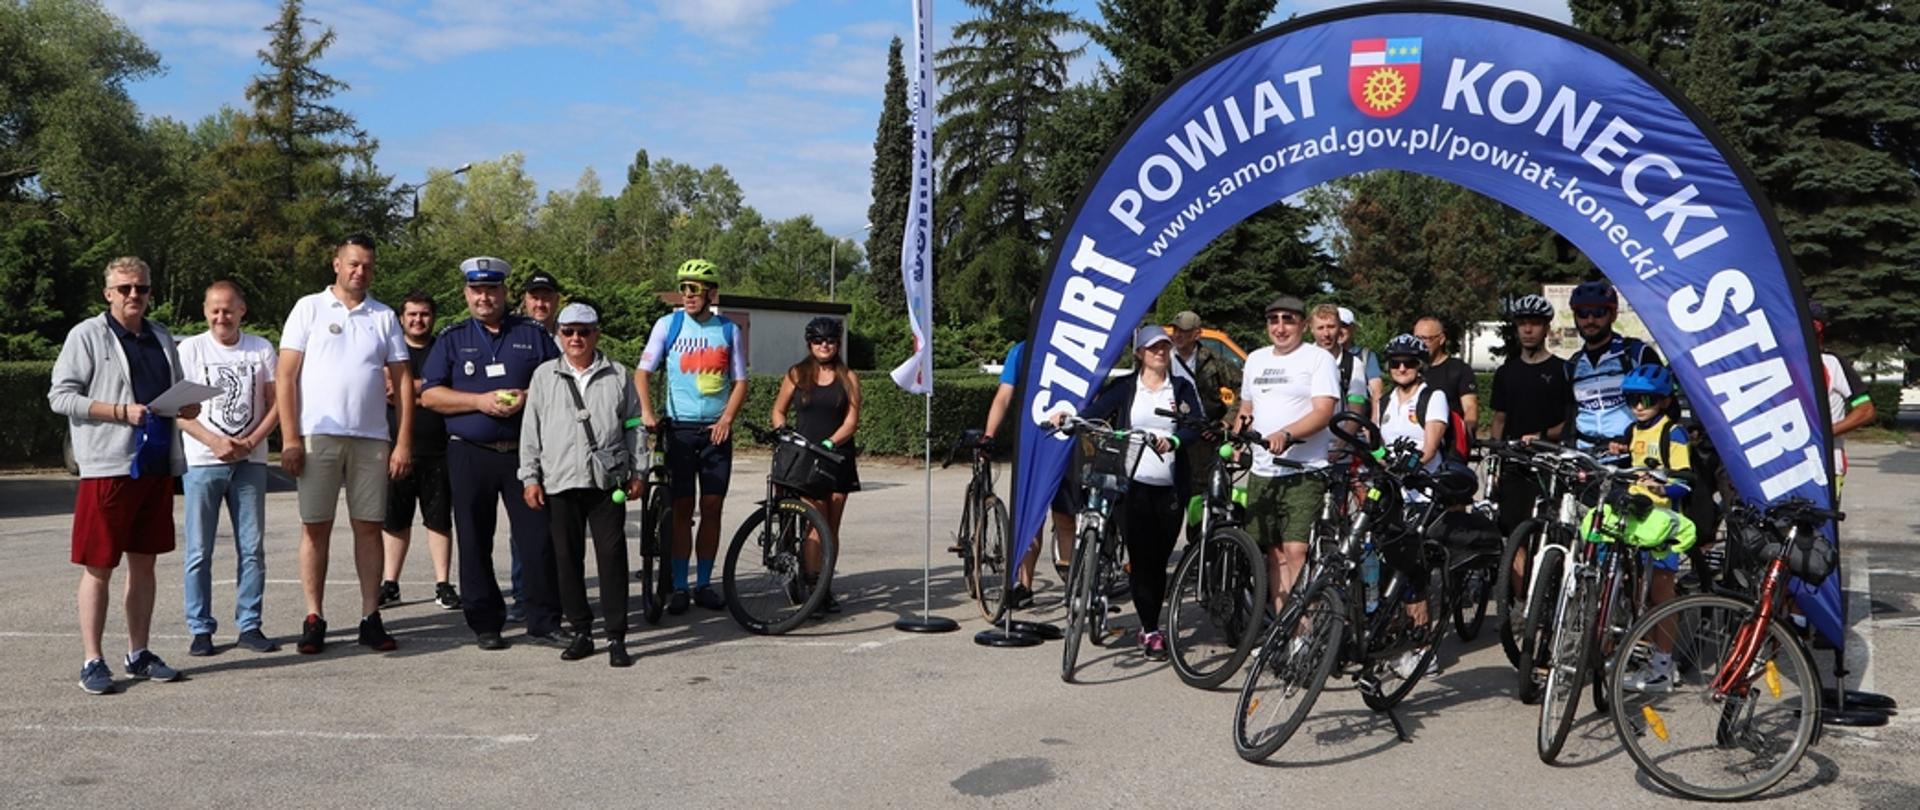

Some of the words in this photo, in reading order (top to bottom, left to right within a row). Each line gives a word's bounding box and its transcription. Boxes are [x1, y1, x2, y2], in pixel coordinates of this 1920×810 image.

[1108, 65, 1323, 236] POWIAT
[1441, 57, 1730, 261] KONECKI
[1146, 126, 1665, 281] www.samorzad.gov.pl/powiat-konecki
[1032, 234, 1137, 441] START
[1667, 268, 1829, 502] START
